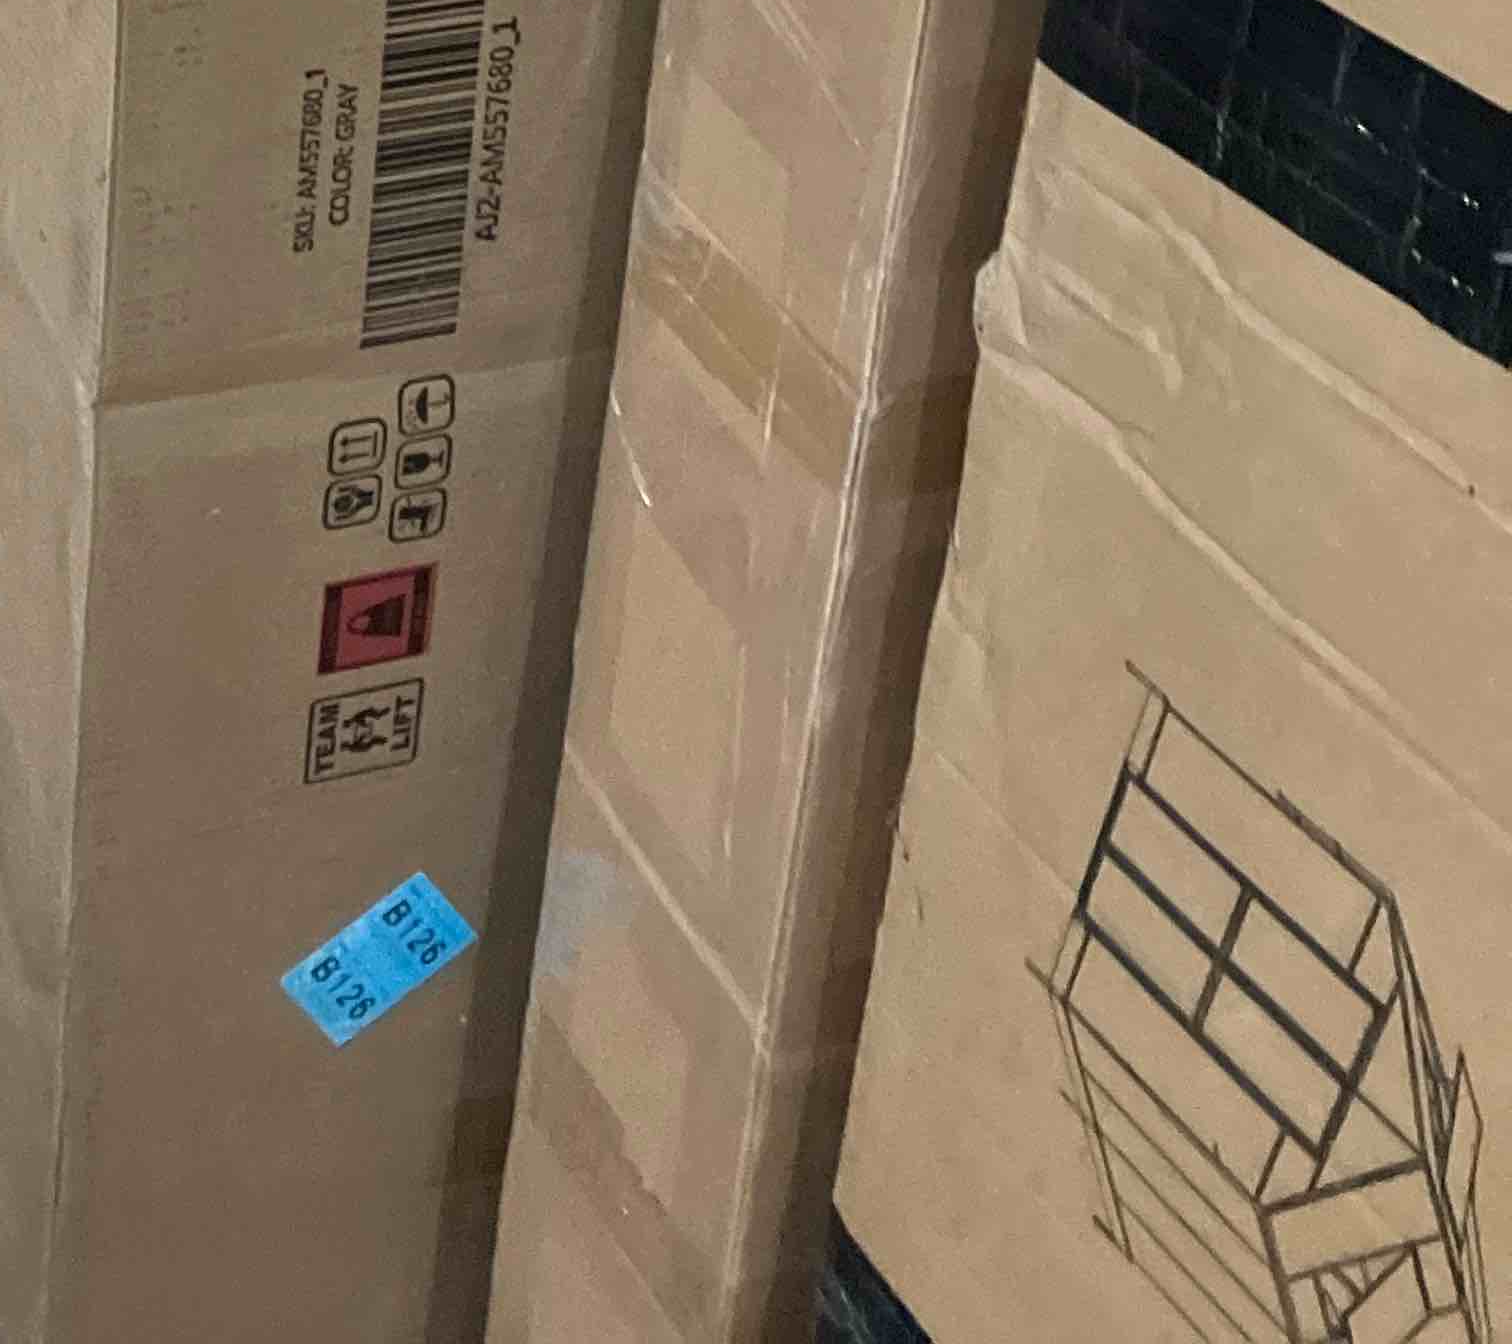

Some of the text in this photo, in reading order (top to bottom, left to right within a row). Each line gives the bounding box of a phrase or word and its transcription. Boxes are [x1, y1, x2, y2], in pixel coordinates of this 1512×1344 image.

[293, 68, 329, 253] SKU: AM557680_1
[329, 83, 361, 226] COLOR: GRAY
[312, 703, 341, 776] TEAM
[390, 695, 418, 750] LIFT
[381, 898, 443, 967] B126
[310, 955, 376, 1021] B126
